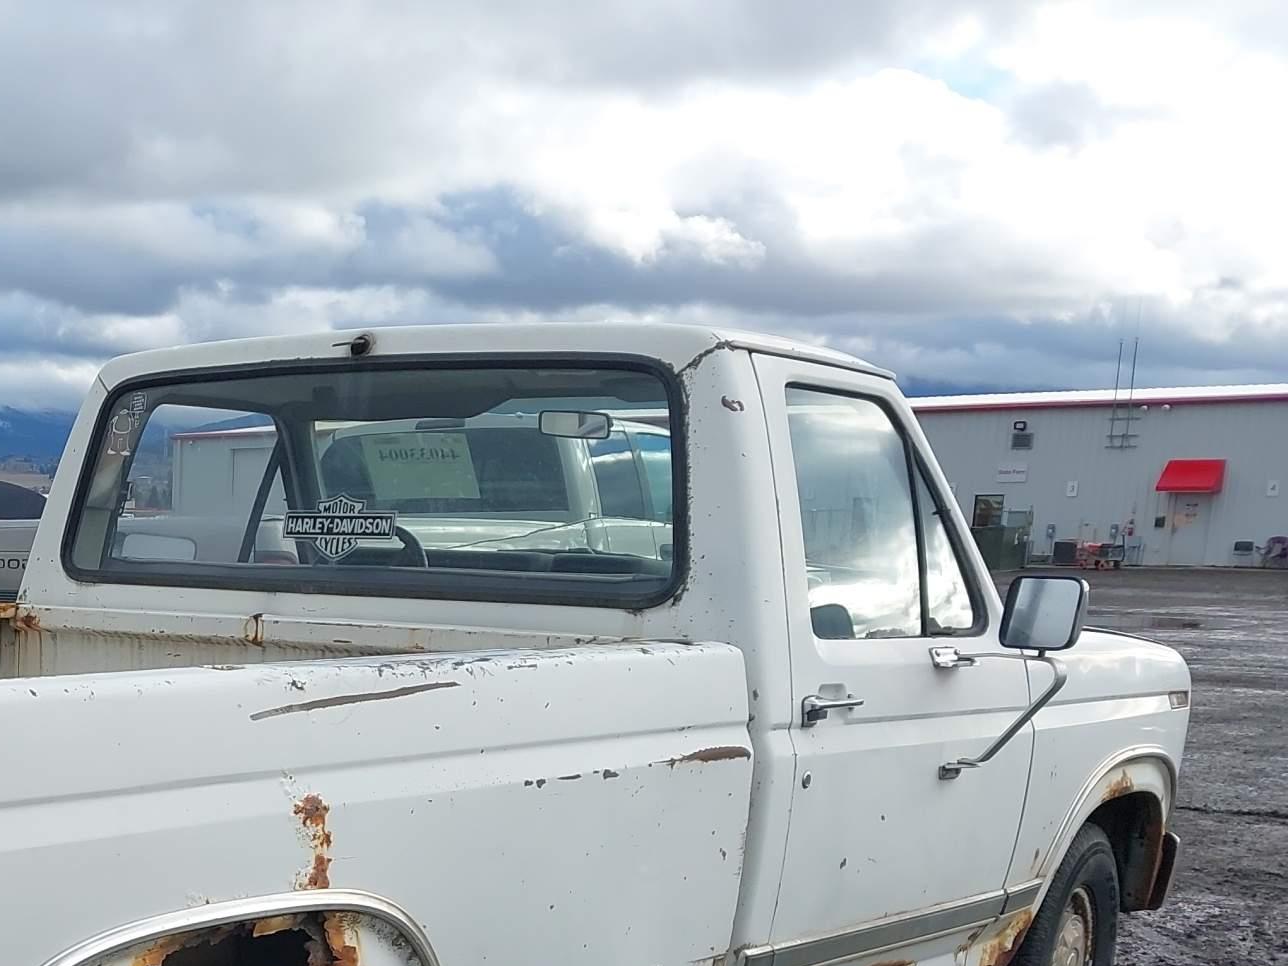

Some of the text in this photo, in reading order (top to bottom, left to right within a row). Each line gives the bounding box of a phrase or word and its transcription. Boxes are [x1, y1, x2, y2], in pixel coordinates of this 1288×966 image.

[323, 499, 356, 514] MOTOR
[287, 517, 392, 534] HARLEY-DAVIDSON
[319, 537, 352, 555] CYCLES
